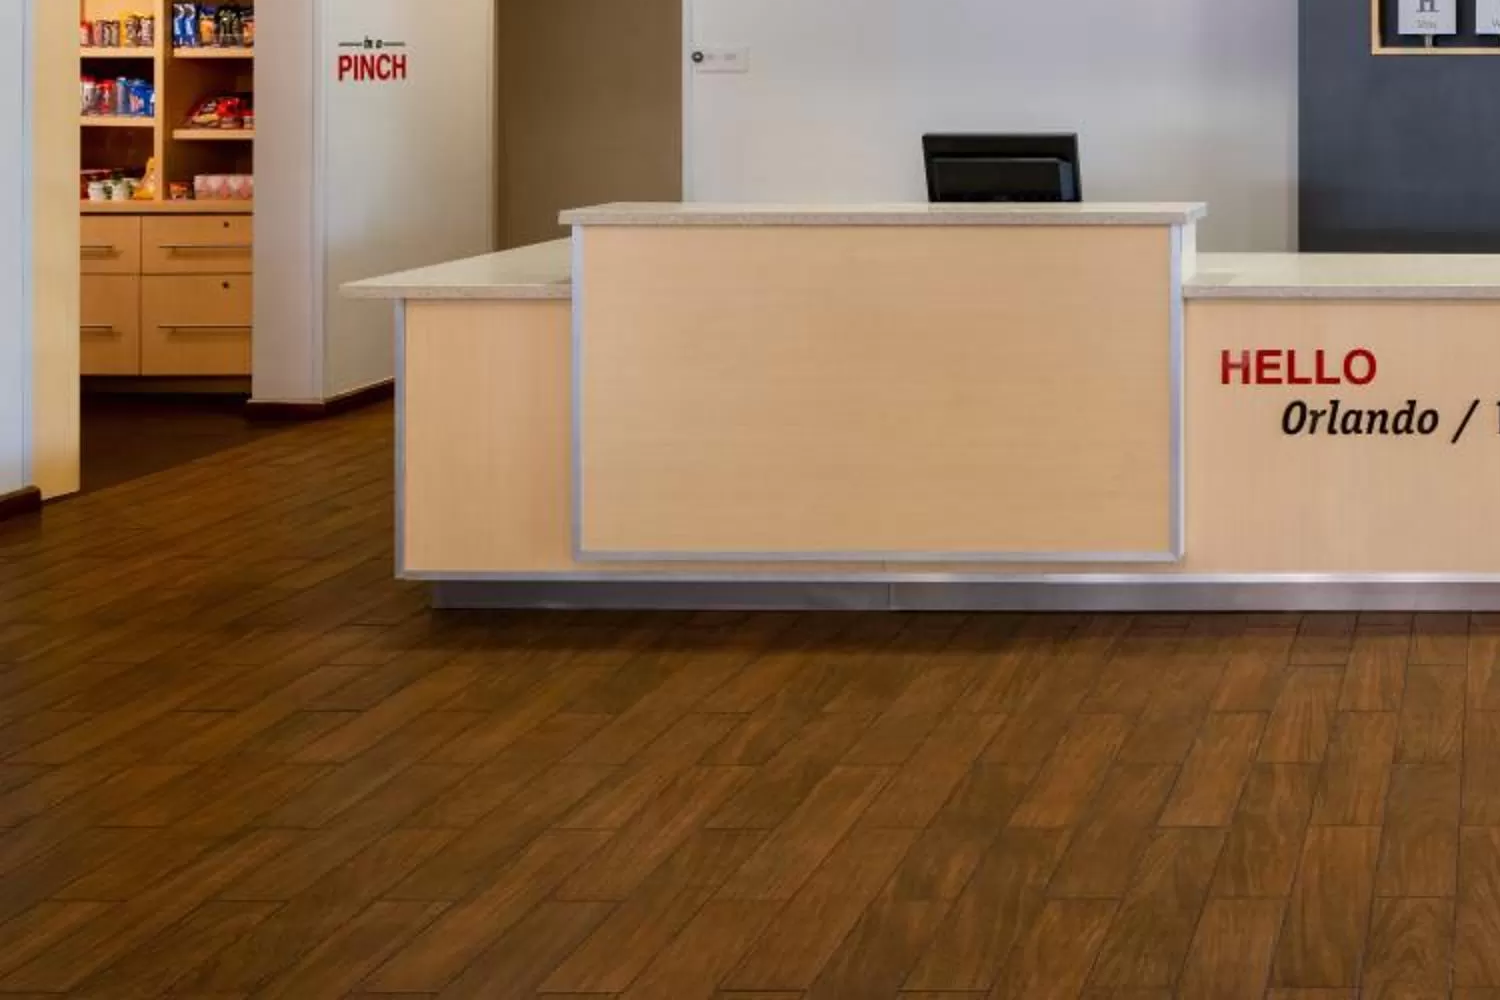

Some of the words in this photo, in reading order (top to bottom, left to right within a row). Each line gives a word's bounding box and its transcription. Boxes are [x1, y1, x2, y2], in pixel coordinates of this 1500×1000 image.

[338, 54, 407, 81] PINCH
[1221, 349, 1377, 386] HELLO
[1281, 399, 1439, 436] Orlando
[1450, 399, 1481, 444] /
